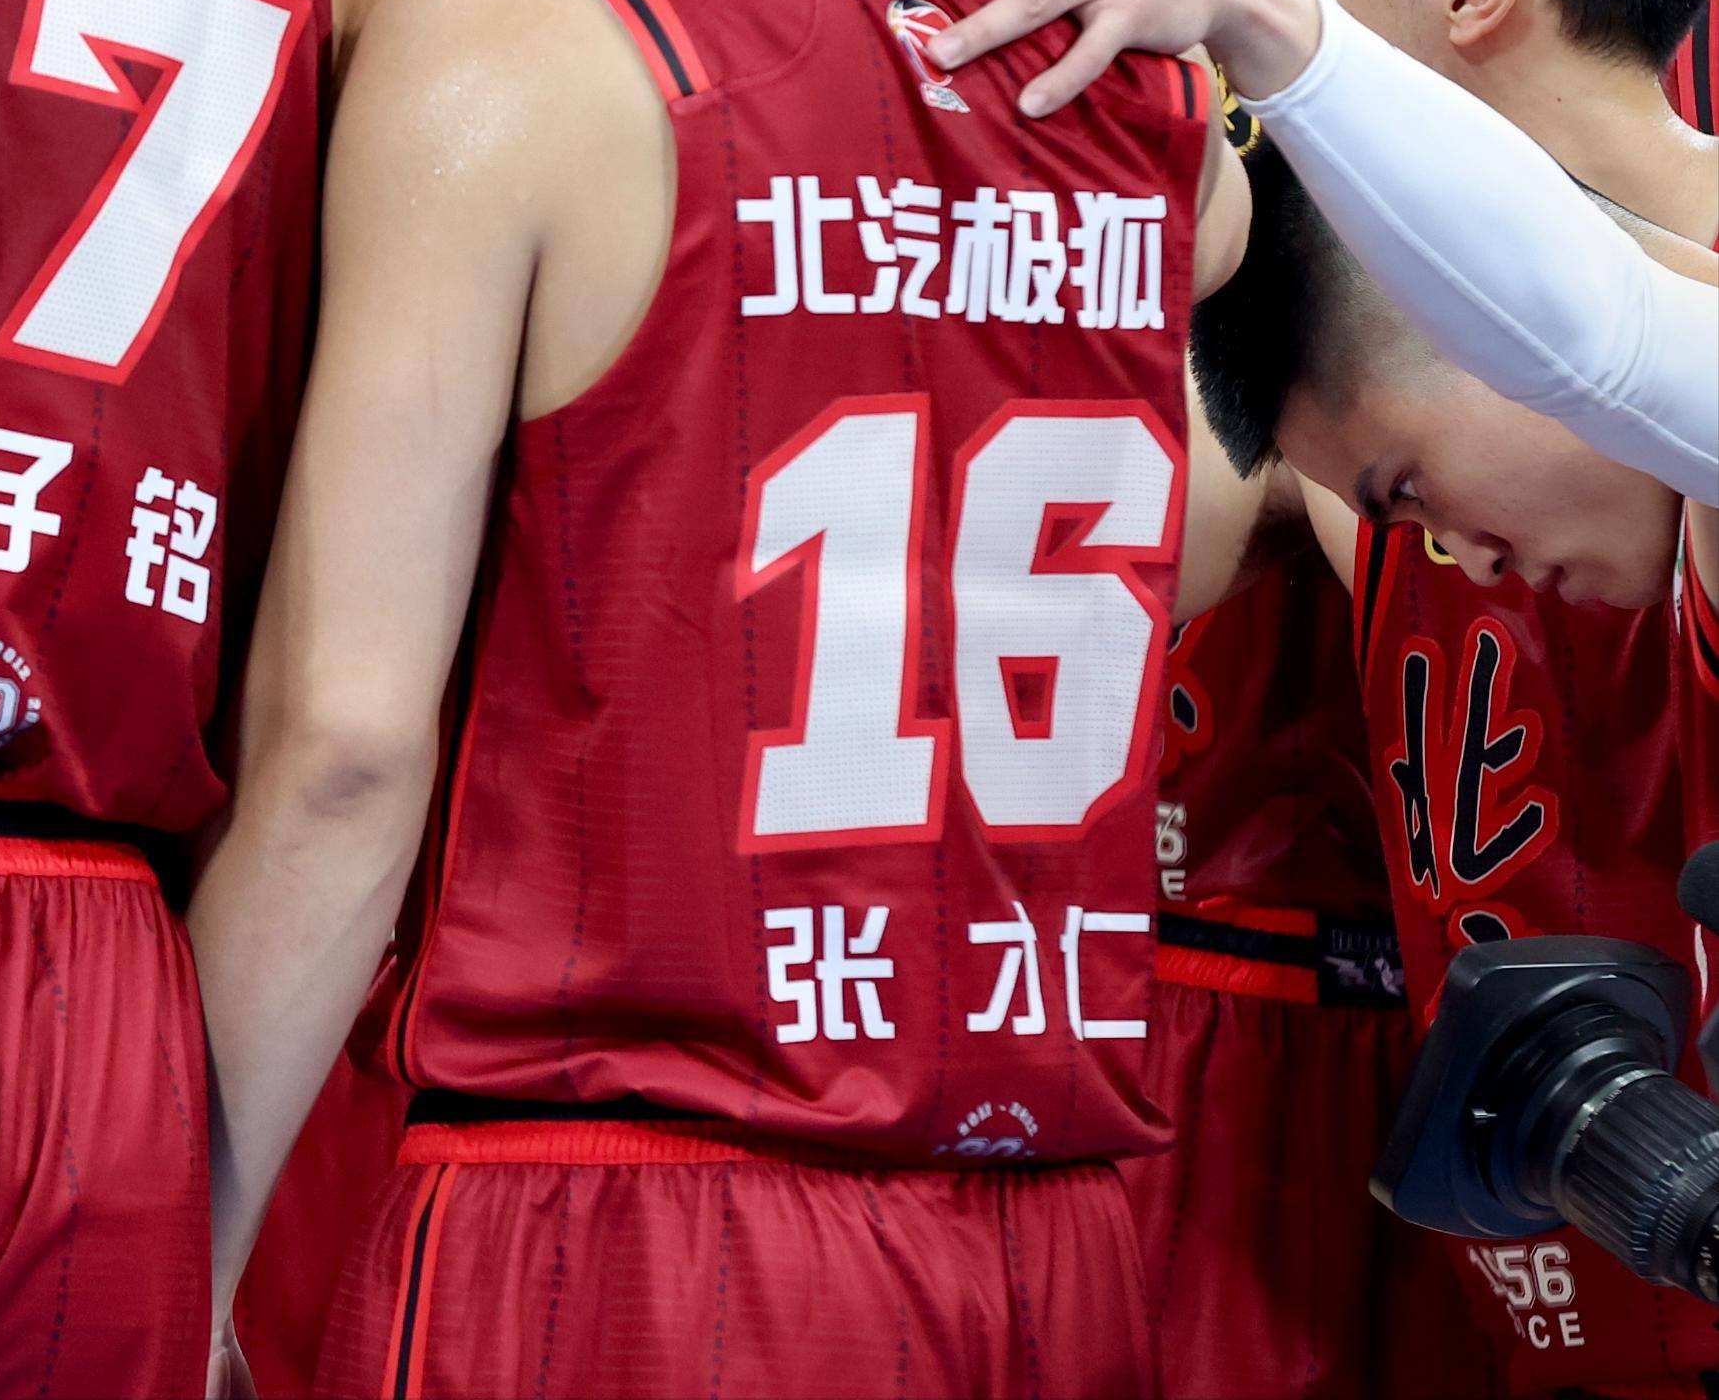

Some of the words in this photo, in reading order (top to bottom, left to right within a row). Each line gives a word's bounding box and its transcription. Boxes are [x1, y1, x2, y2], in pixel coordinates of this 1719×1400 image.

[736, 175, 1168, 330] 北汽极狐
[736, 391, 1188, 855] 16
[1387, 628, 1548, 942] 北
[764, 901, 1152, 1044] 张才仁
